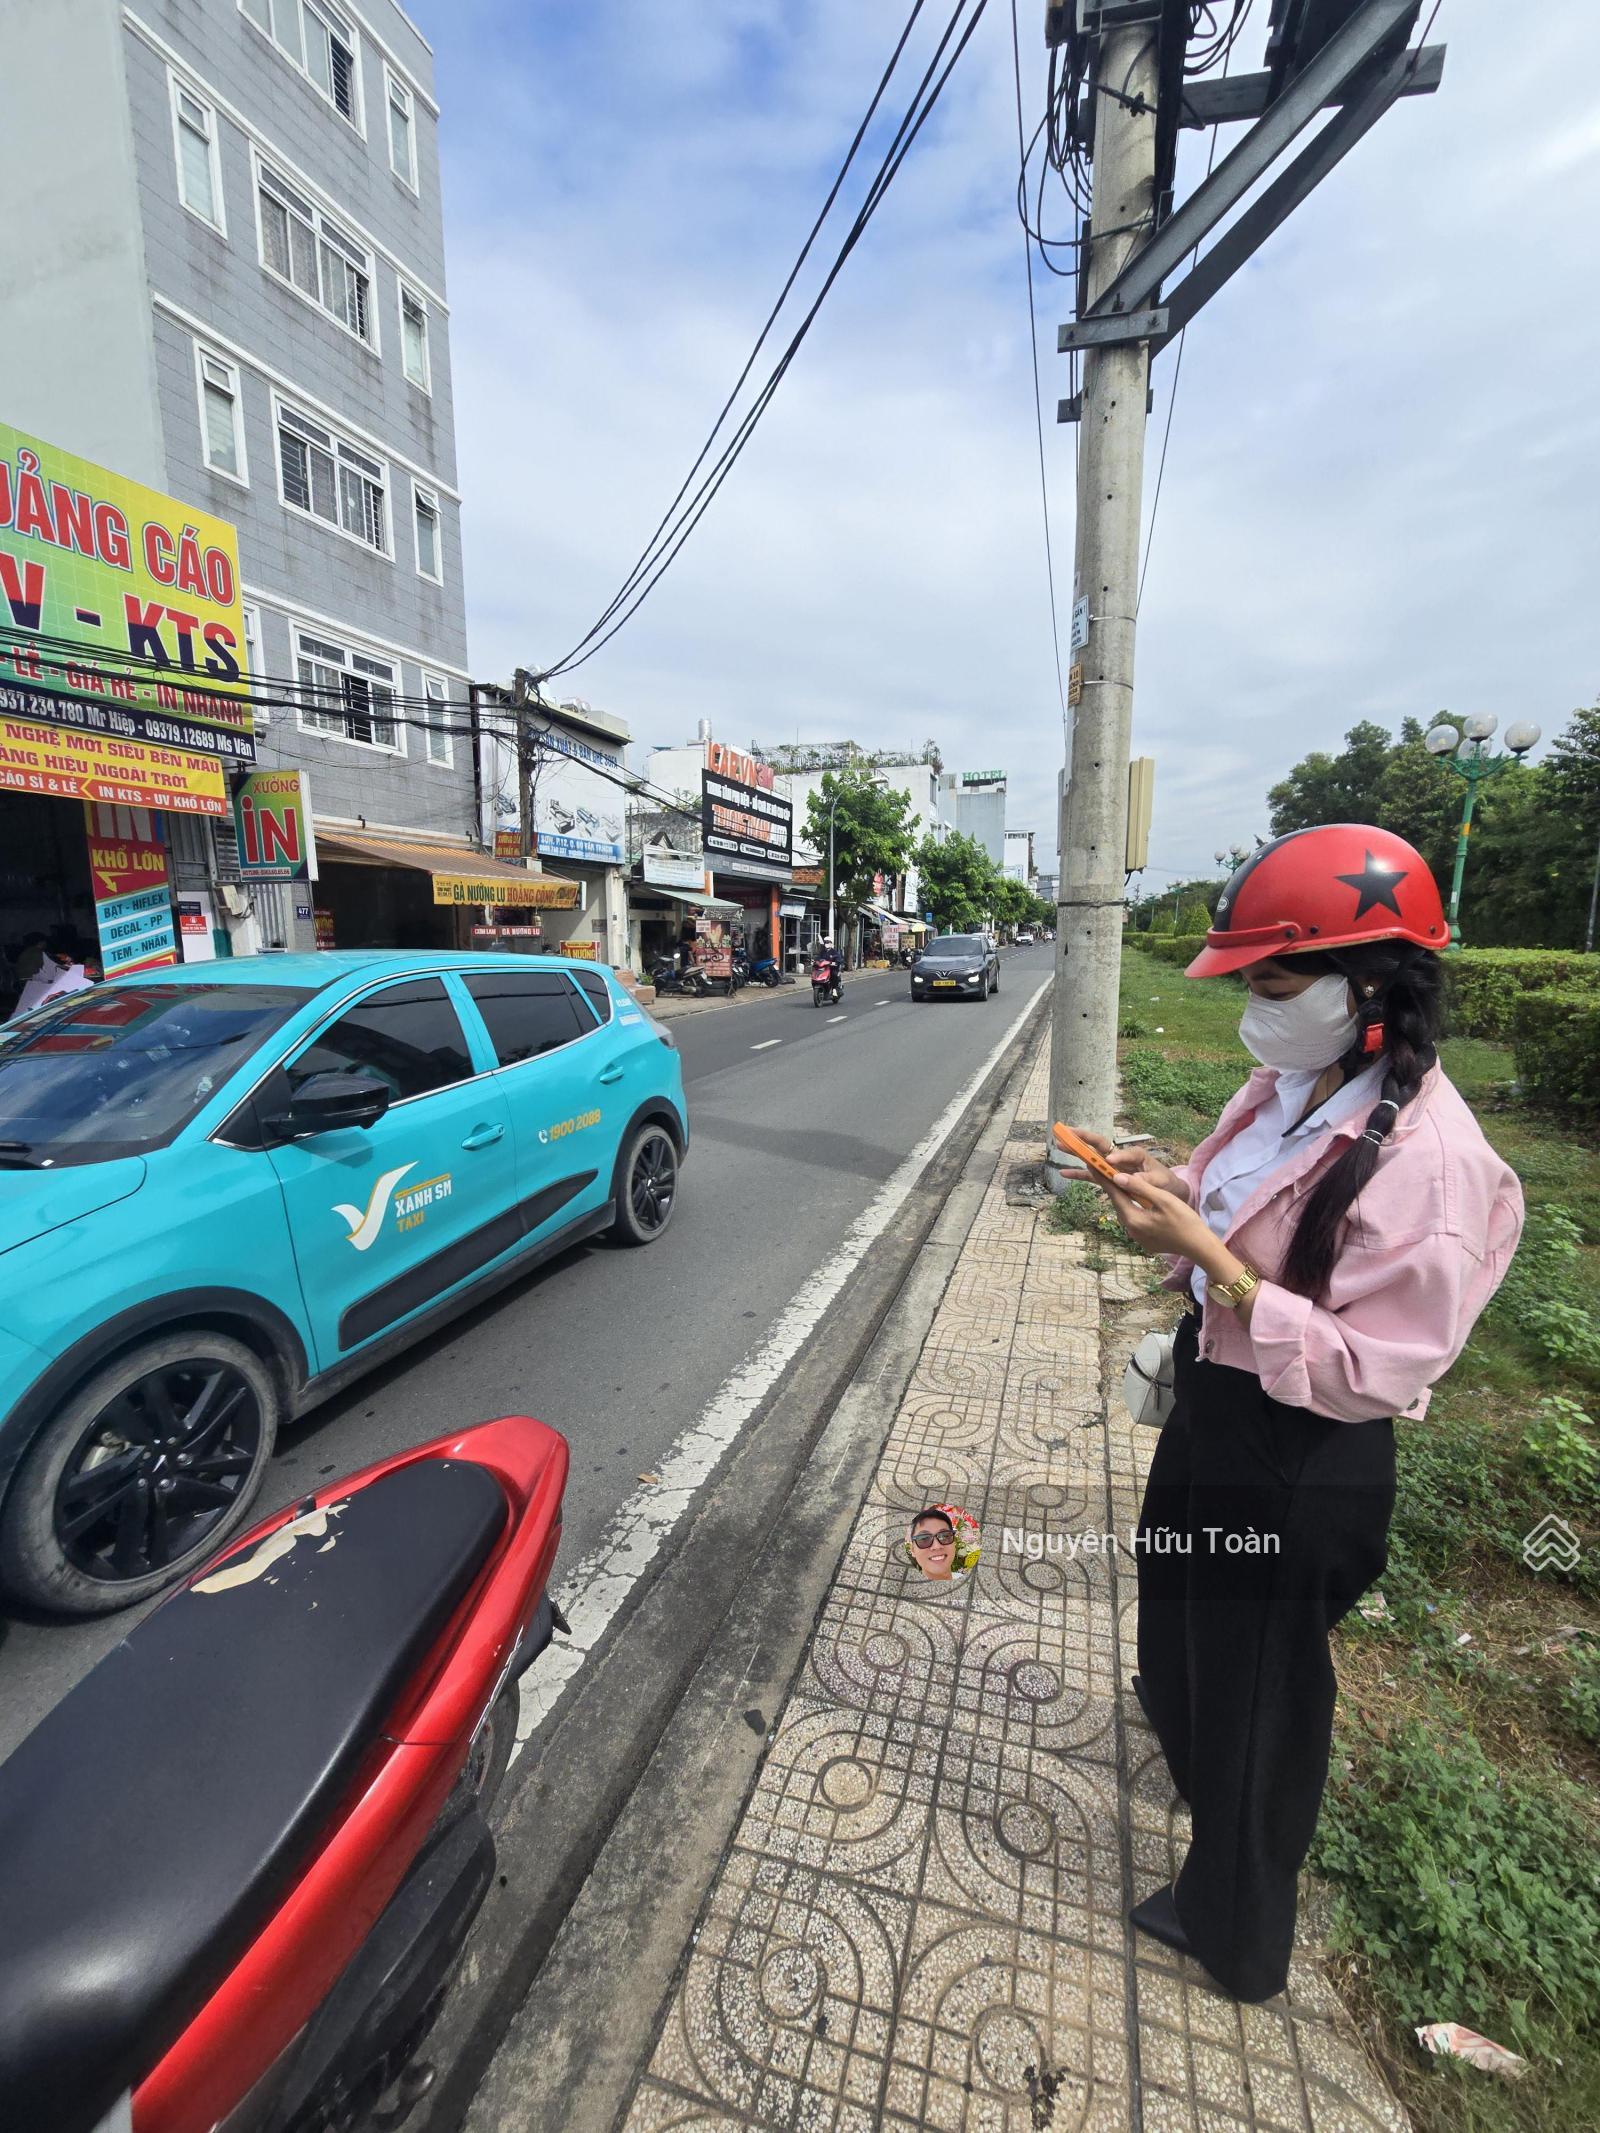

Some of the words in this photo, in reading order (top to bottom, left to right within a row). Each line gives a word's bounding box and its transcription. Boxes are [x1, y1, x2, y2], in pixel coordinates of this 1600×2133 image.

[142, 523, 235, 607] CÁO
[124, 593, 239, 682] KTS
[156, 683, 179, 711] IN
[183, 690, 244, 726] NHANH
[85, 705, 106, 727] Mr
[108, 710, 135, 736] Hiệp
[145, 718, 215, 748] 09379.12689
[216, 733, 233, 753] Ms
[234, 738, 253, 757] Vân
[5, 723, 60, 748] NGHỆ
[65, 735, 103, 753] MỚI
[107, 743, 145, 761] SIÊU
[150, 747, 182, 767] BỀN
[186, 757, 220, 773] MÀU
[44, 754, 88, 775] HIỆU
[93, 763, 147, 783] NGOÀI
[151, 772, 188, 789] TRỜI
[48, 778, 58, 791] &
[253, 775, 299, 794] XƯỞNG
[963, 770, 1005, 780] HOTEL
[98, 785, 114, 798] IN
[118, 788, 142, 802] KTS
[154, 793, 170, 806] UV
[174, 794, 198, 809] KHỔ
[200, 799, 222, 813] LỚN
[92, 844, 128, 868] KHỔ
[133, 850, 165, 872] LỚN
[453, 881, 465, 901] GÀ
[467, 882, 494, 902] NƯỚNG
[497, 887, 505, 901] LU
[104, 904, 123, 919] BẠT
[133, 892, 164, 912] HIFLEX
[110, 919, 142, 939] DECAL
[151, 914, 163, 928] PP
[111, 947, 132, 962] TEM
[549, 1118, 574, 1142] 1900
[395, 1188, 433, 1218] XANH
[435, 1179, 452, 1200] SM
[397, 1211, 425, 1233] TAXI
